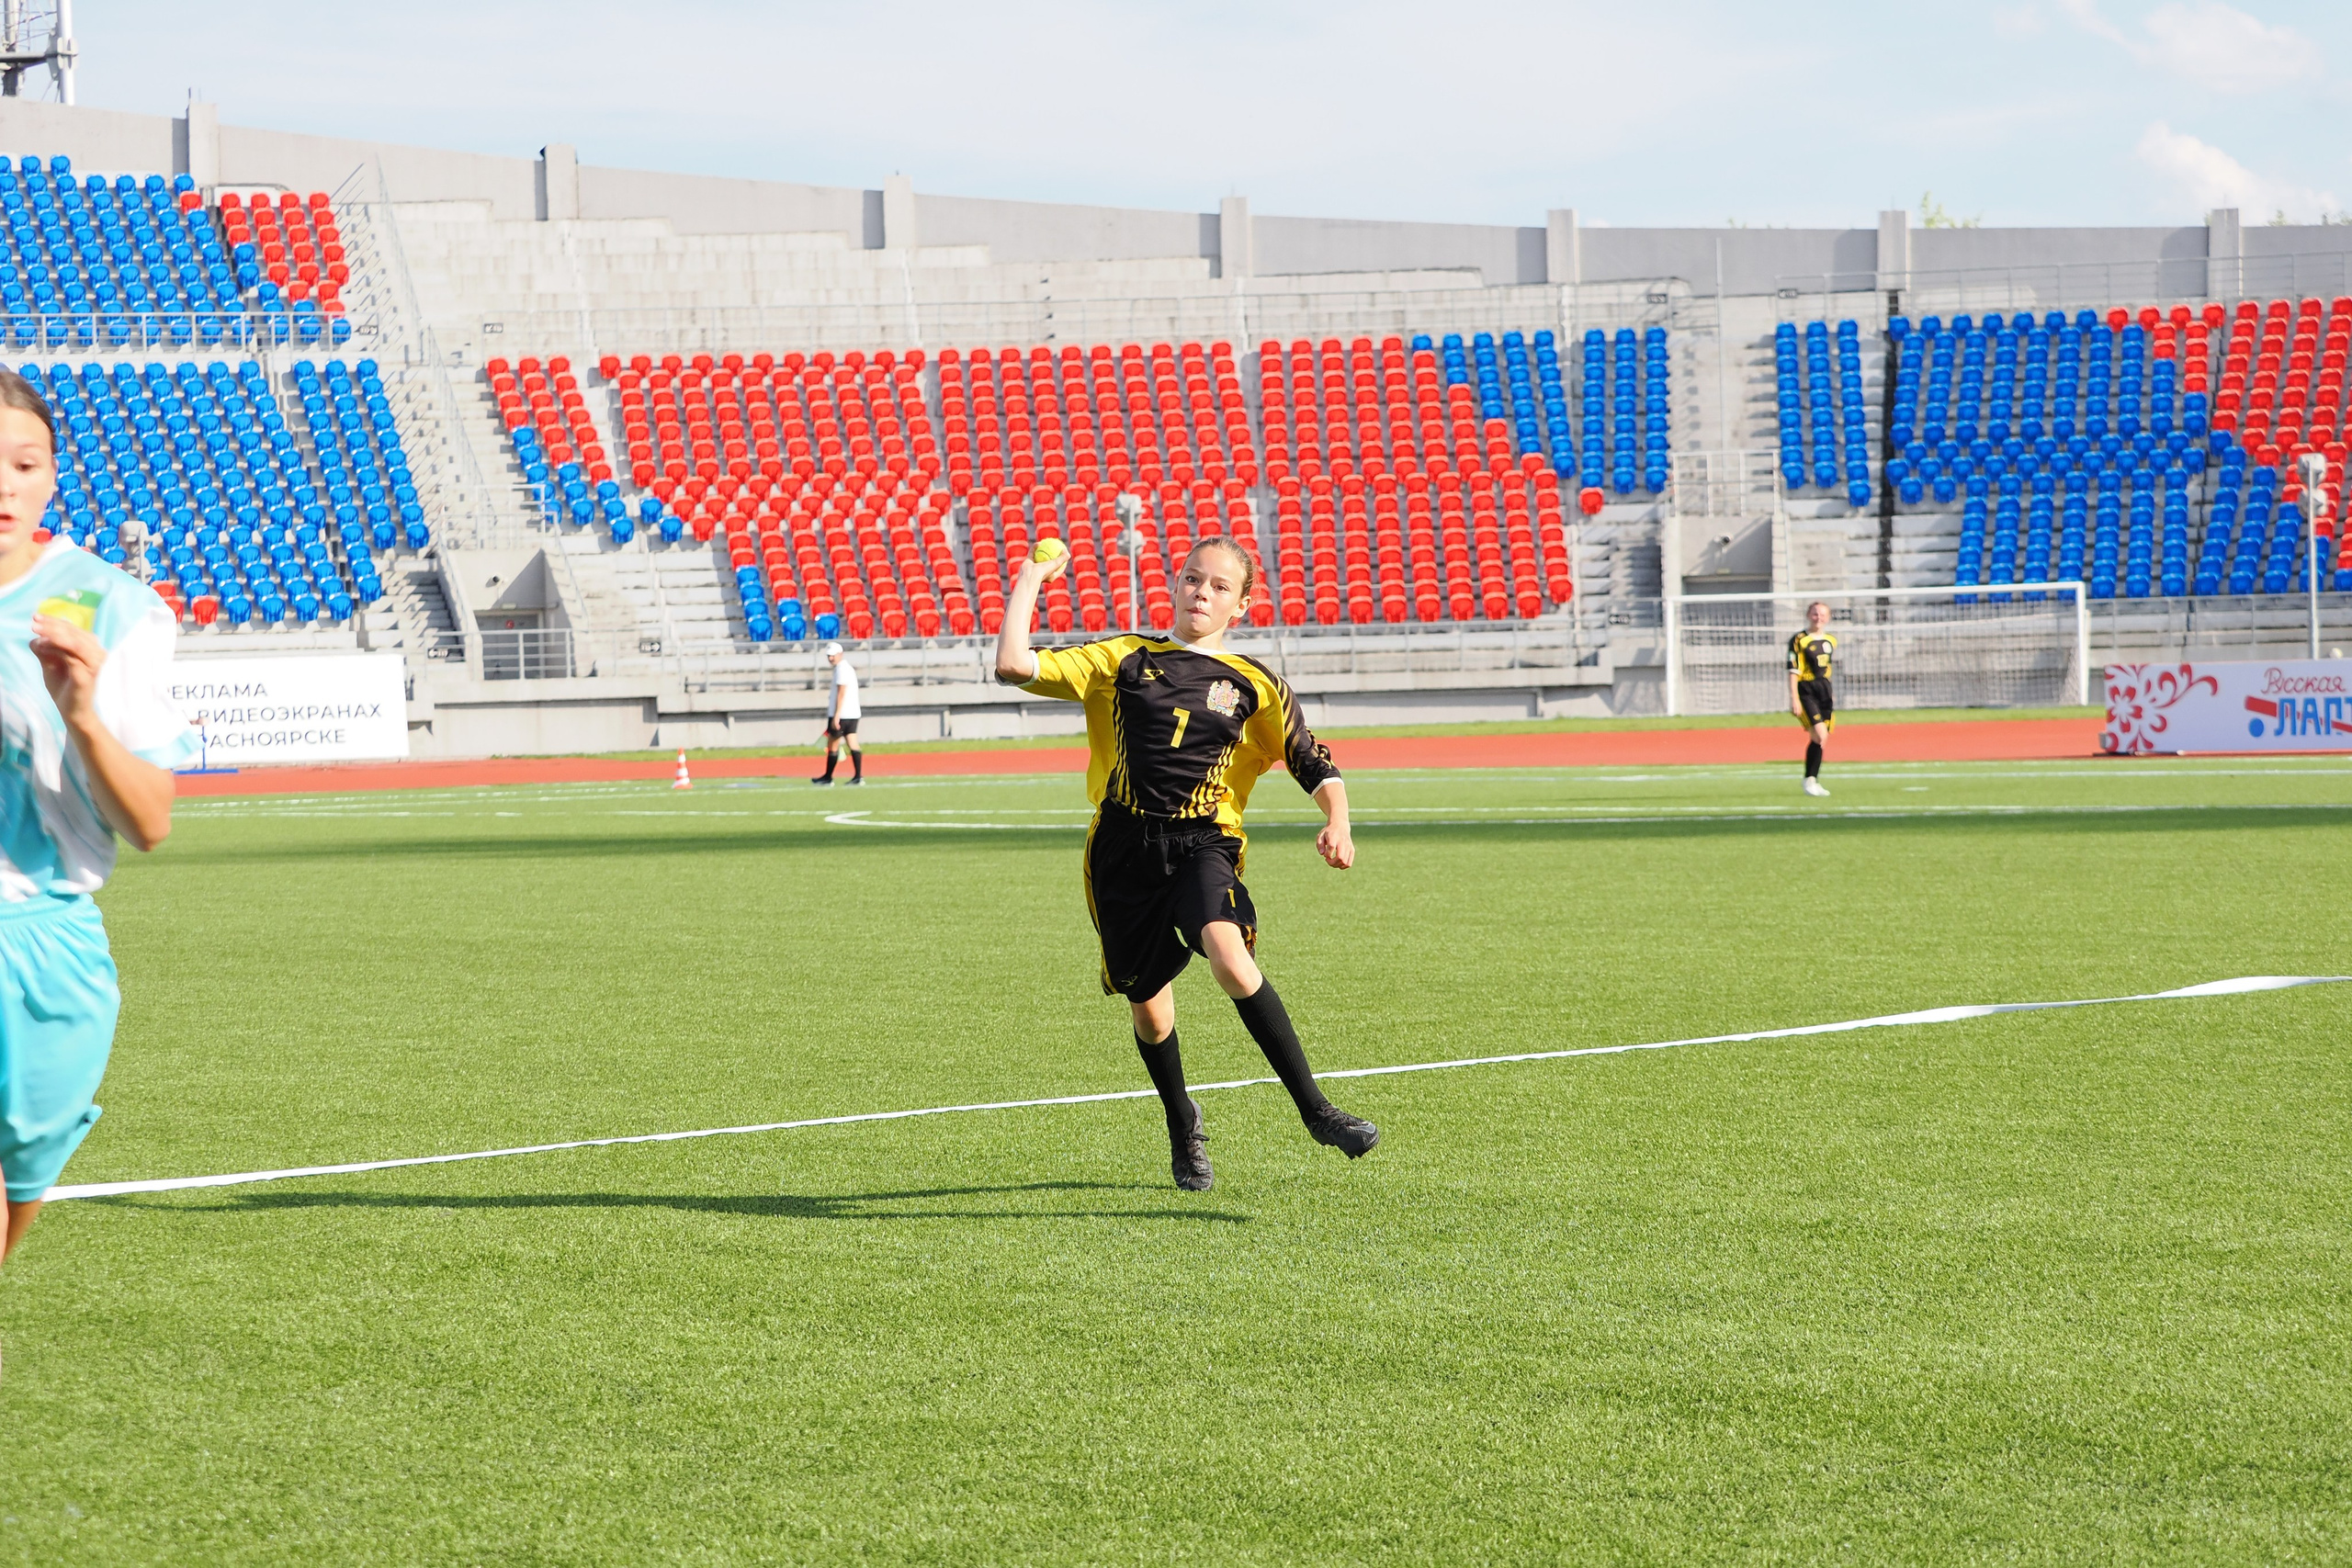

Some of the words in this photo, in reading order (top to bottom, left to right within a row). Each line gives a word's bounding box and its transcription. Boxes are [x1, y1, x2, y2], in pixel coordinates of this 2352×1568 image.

[168, 683, 267, 699] ЕКЛАМА
[2261, 667, 2346, 694] Русская
[204, 728, 346, 749] АСНОЯРСКЕ
[1170, 707, 1191, 749] 1
